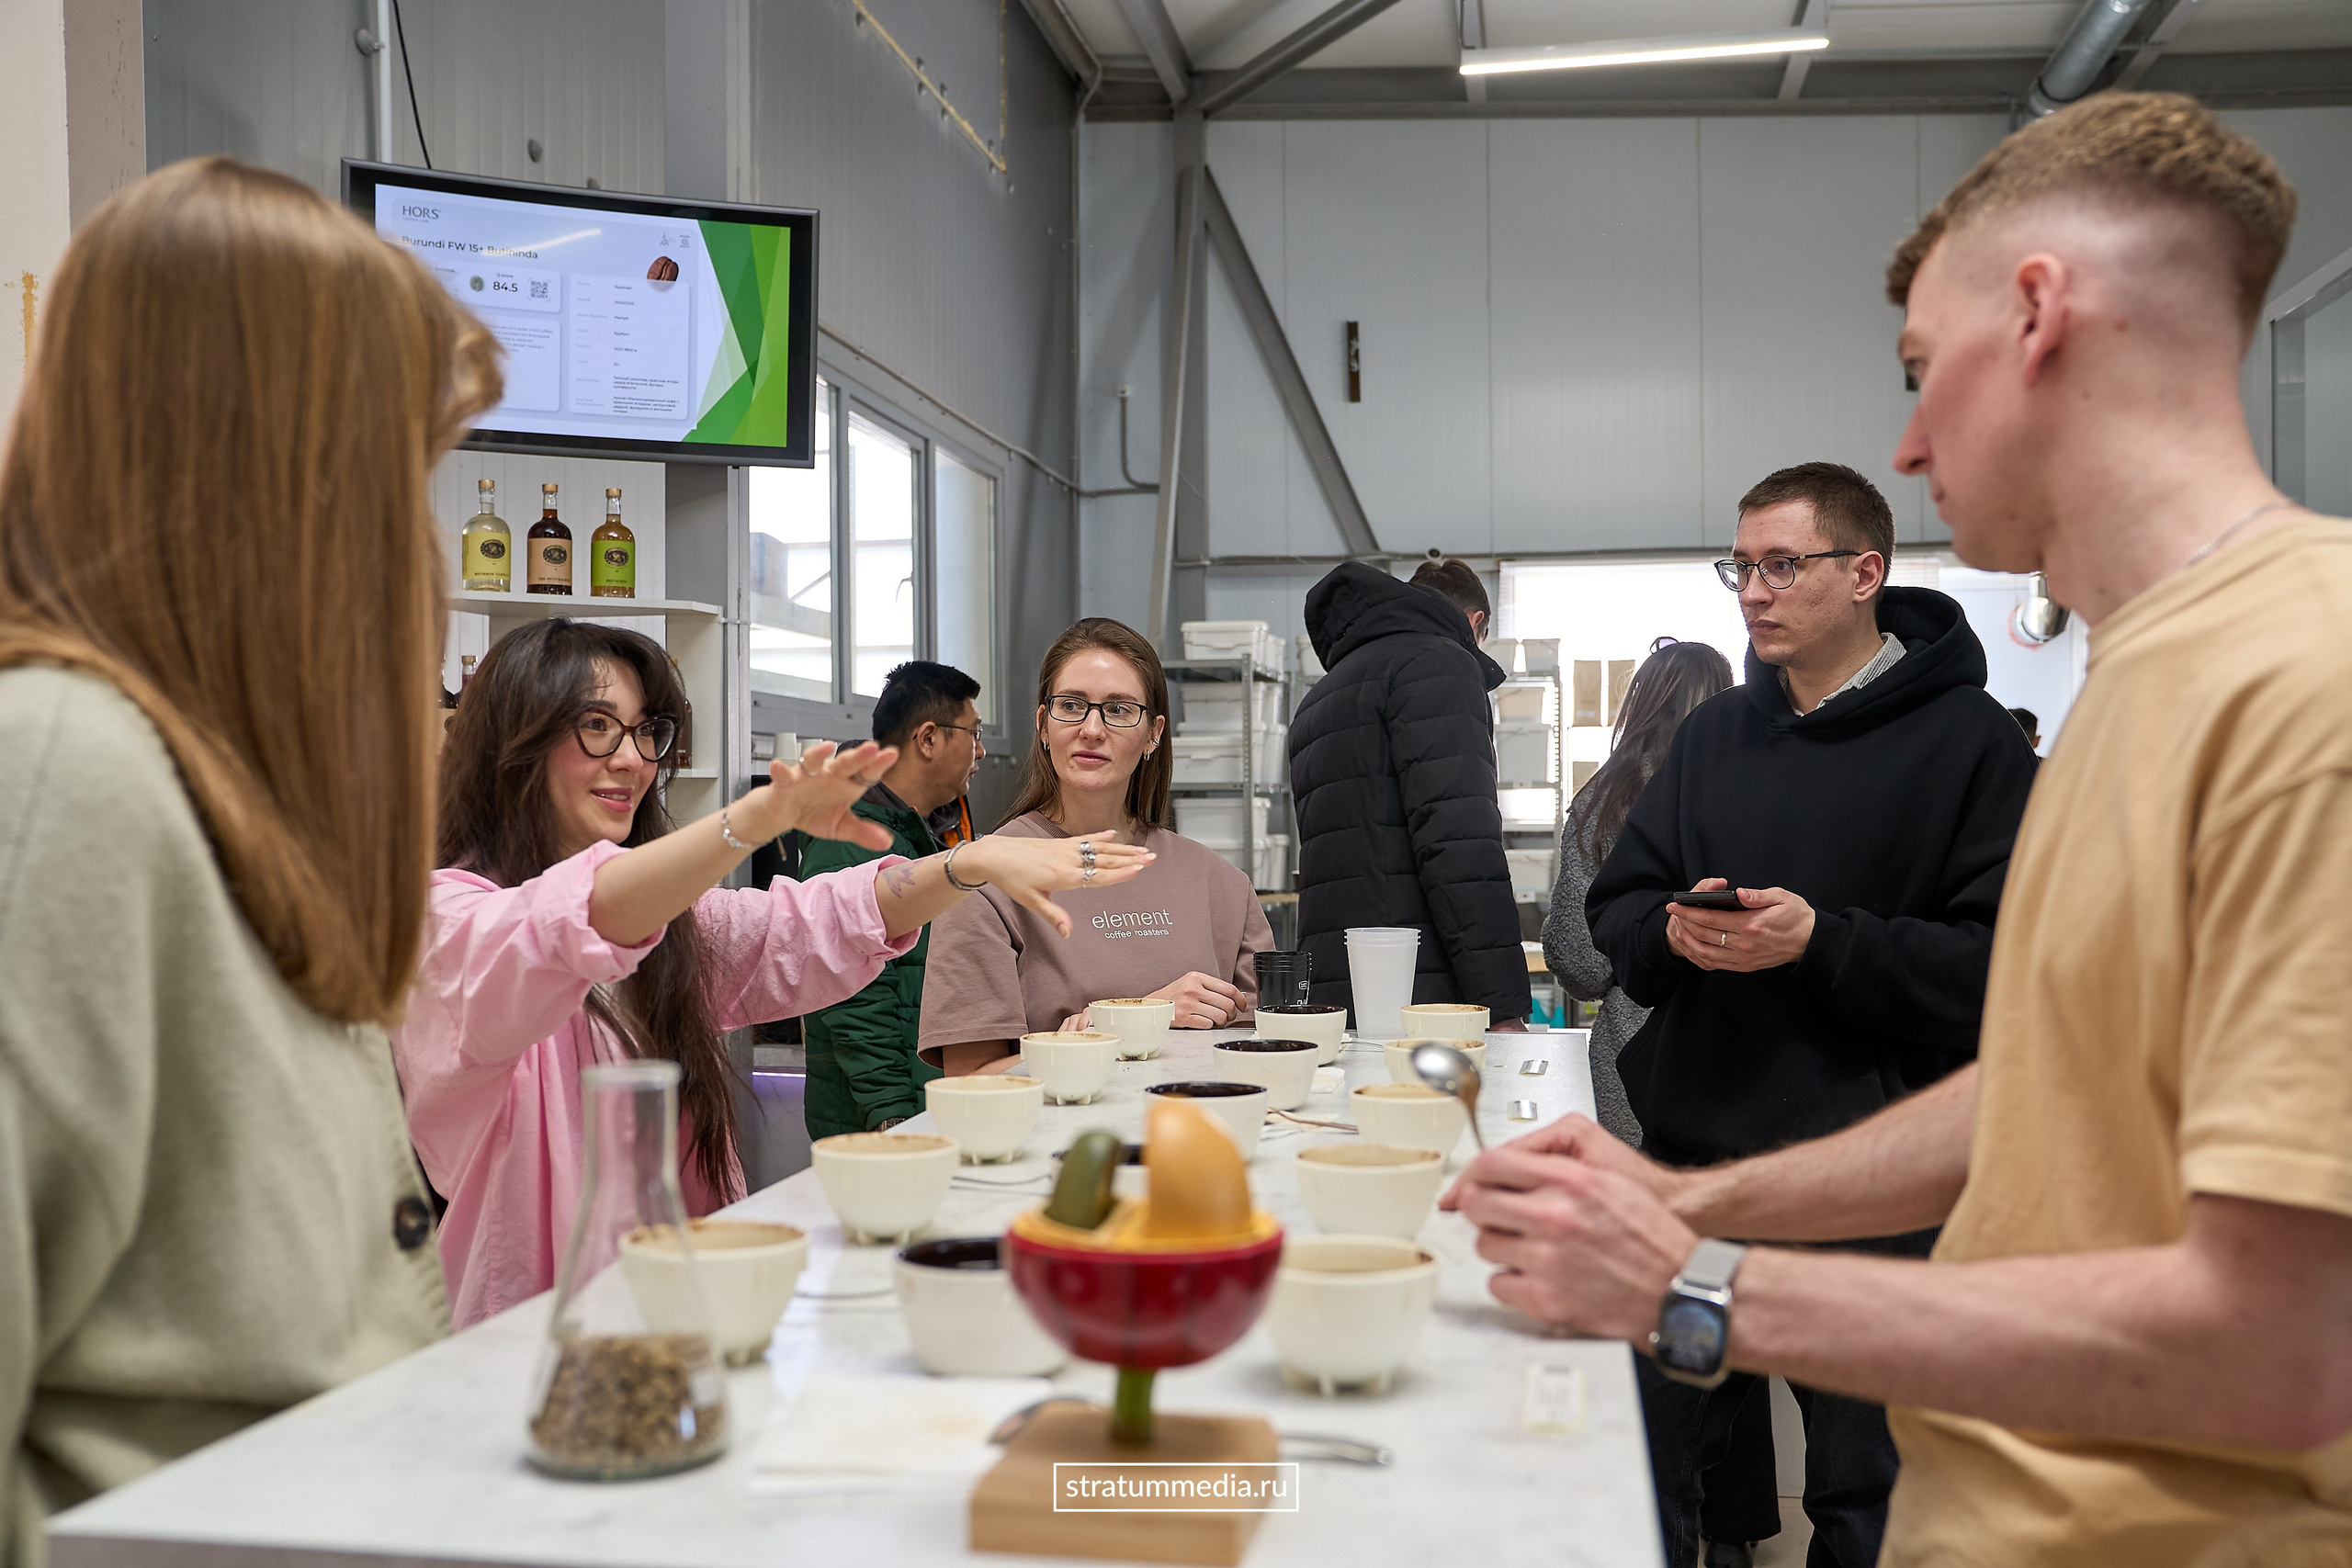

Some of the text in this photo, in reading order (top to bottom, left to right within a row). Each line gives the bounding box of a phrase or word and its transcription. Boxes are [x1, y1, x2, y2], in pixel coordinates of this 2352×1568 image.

[402, 205, 439, 220] HORS
[401, 236, 538, 259] Burundi FW 15+ Butihinda
[492, 281, 518, 292] 84.5
[1091, 908, 1173, 929] element
[1104, 928, 1170, 939] coffee roasters
